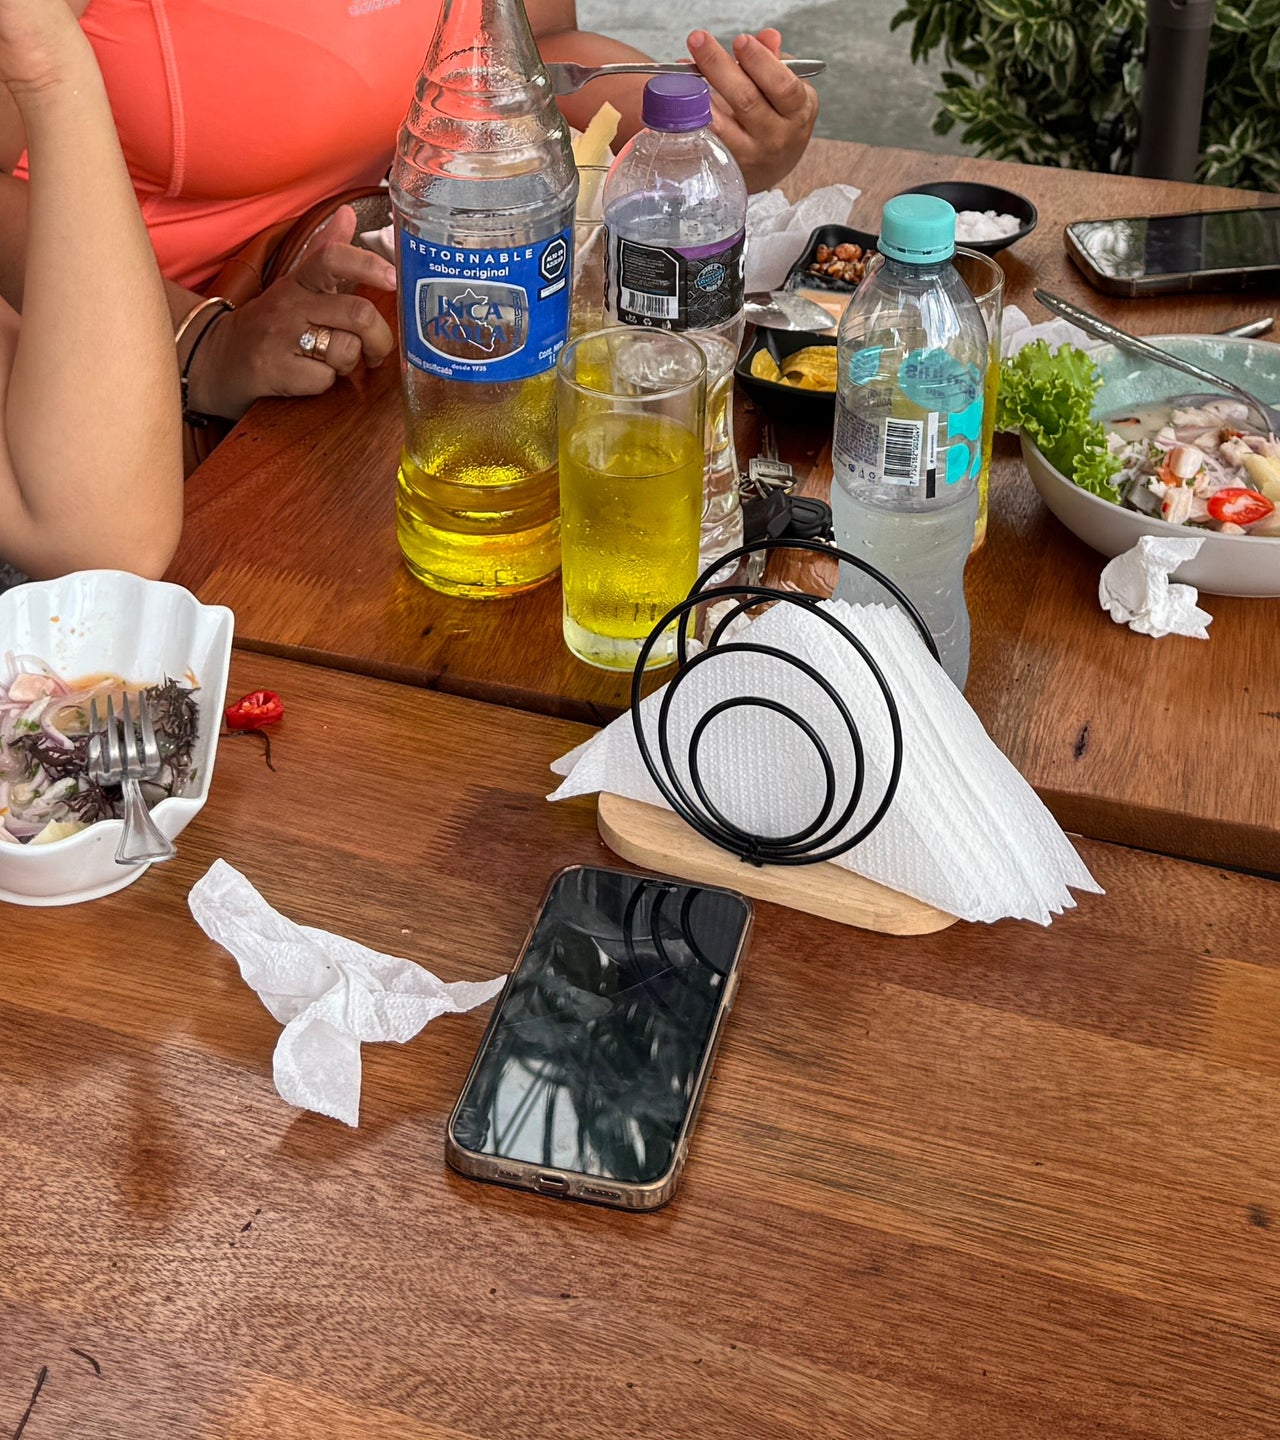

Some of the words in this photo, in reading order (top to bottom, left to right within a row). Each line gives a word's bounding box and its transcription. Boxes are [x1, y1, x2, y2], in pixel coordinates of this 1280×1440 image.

[409, 239, 534, 264] RETORNABLE
[428, 262, 461, 276] sabor
[463, 266, 510, 280] original
[437, 294, 504, 321] INCA
[434, 316, 508, 344] KOLA
